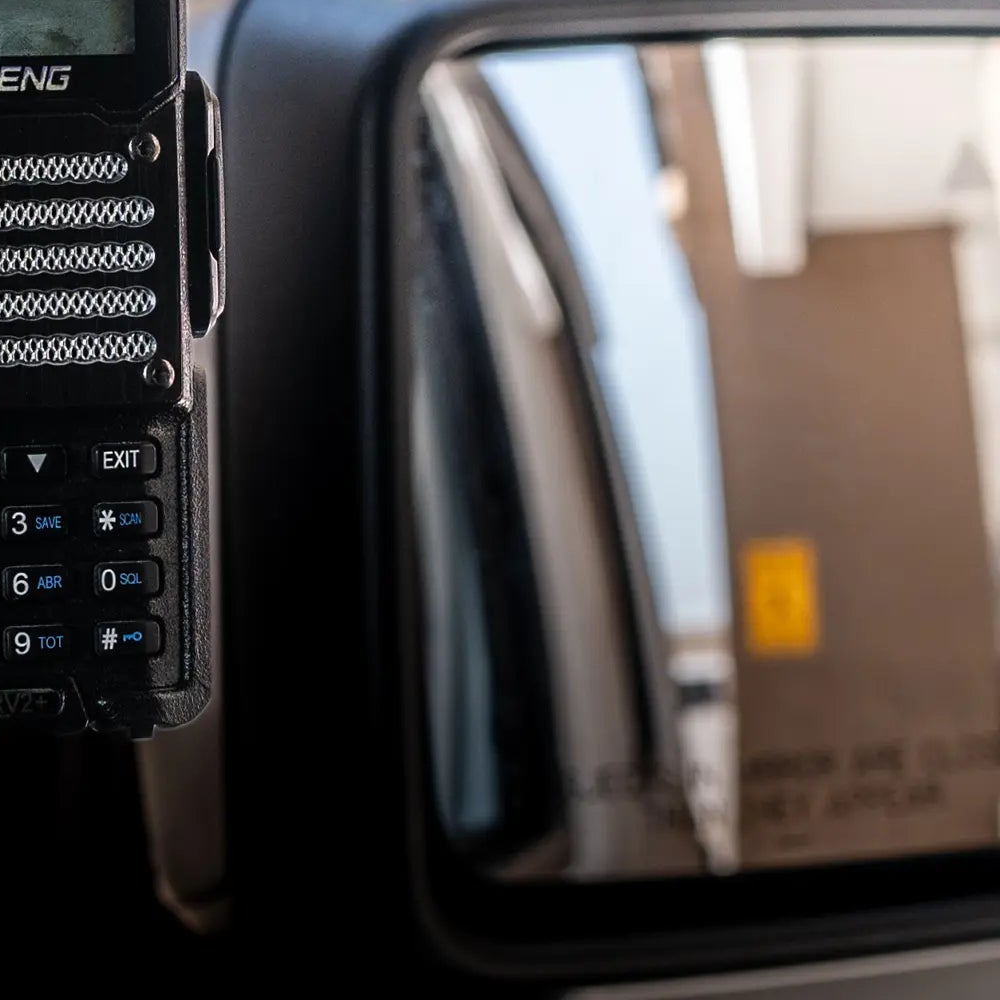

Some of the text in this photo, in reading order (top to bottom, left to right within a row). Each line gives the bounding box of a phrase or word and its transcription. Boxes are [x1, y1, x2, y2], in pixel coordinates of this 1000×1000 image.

[103, 449, 140, 469] EXIT
[11, 511, 62, 535] 3 SAVE
[119, 512, 142, 526] SCAN
[12, 572, 63, 596] 6 ABR
[101, 568, 142, 591] 0 SQL
[14, 631, 64, 655] 9 TOT
[101, 627, 118, 650] #
